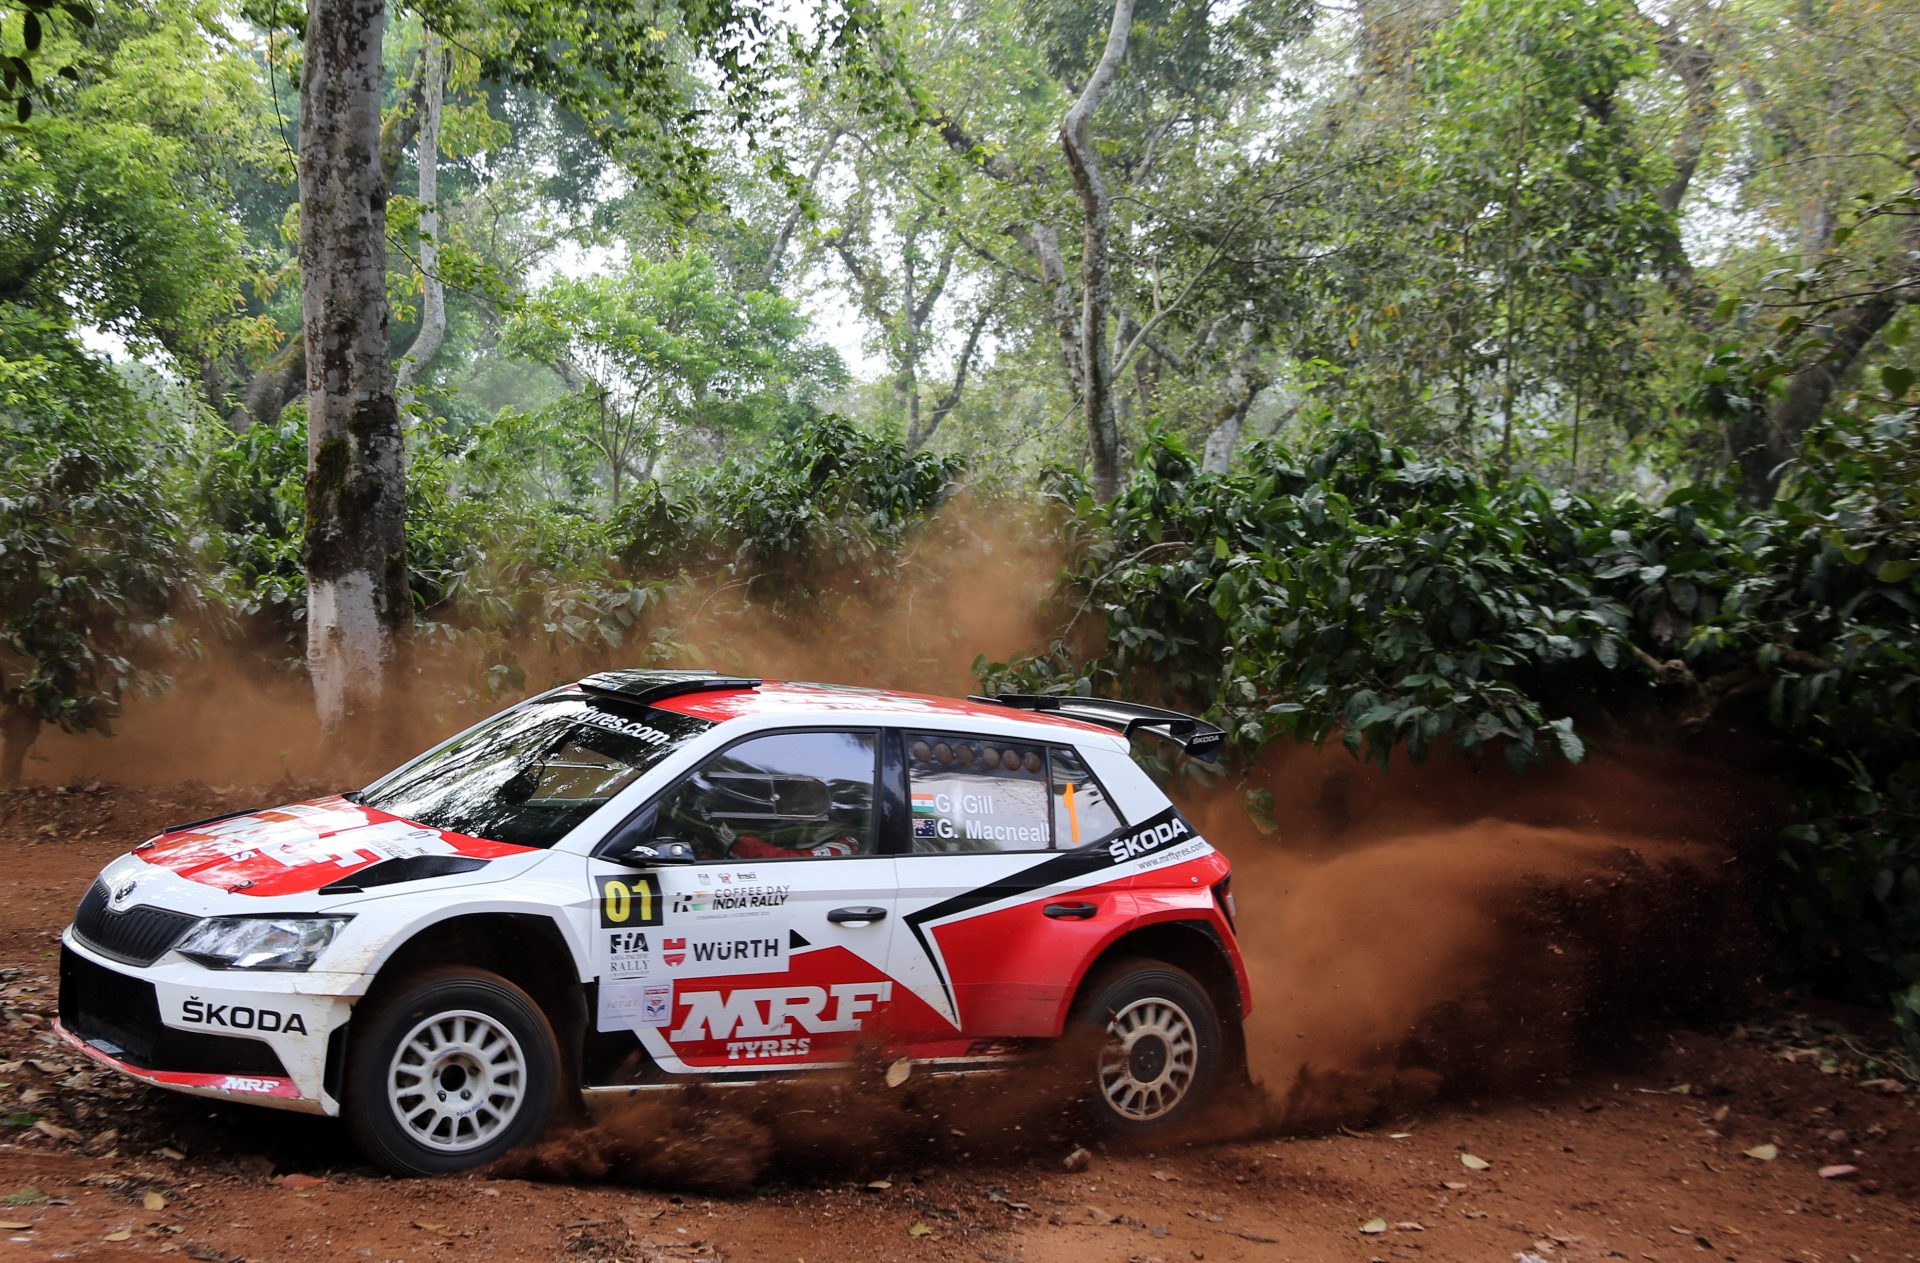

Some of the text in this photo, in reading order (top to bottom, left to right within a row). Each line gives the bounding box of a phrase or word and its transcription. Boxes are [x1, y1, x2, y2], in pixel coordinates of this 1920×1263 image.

[1192, 735, 1219, 745] ŠKODA
[963, 795, 994, 815] Gill
[1063, 781, 1081, 844] 1
[937, 818, 1051, 843] G. Macneall
[1108, 817, 1189, 863] ŠKODA
[604, 879, 653, 923] 01
[712, 894, 790, 911] INDIA RALLY
[714, 884, 791, 899] COFFEE DAY
[610, 959, 650, 972] RALLY
[182, 995, 308, 1036] ŠKODA
[670, 981, 893, 1042] MRF
[726, 1037, 812, 1061] TYRES
[221, 1076, 280, 1093] MRF
